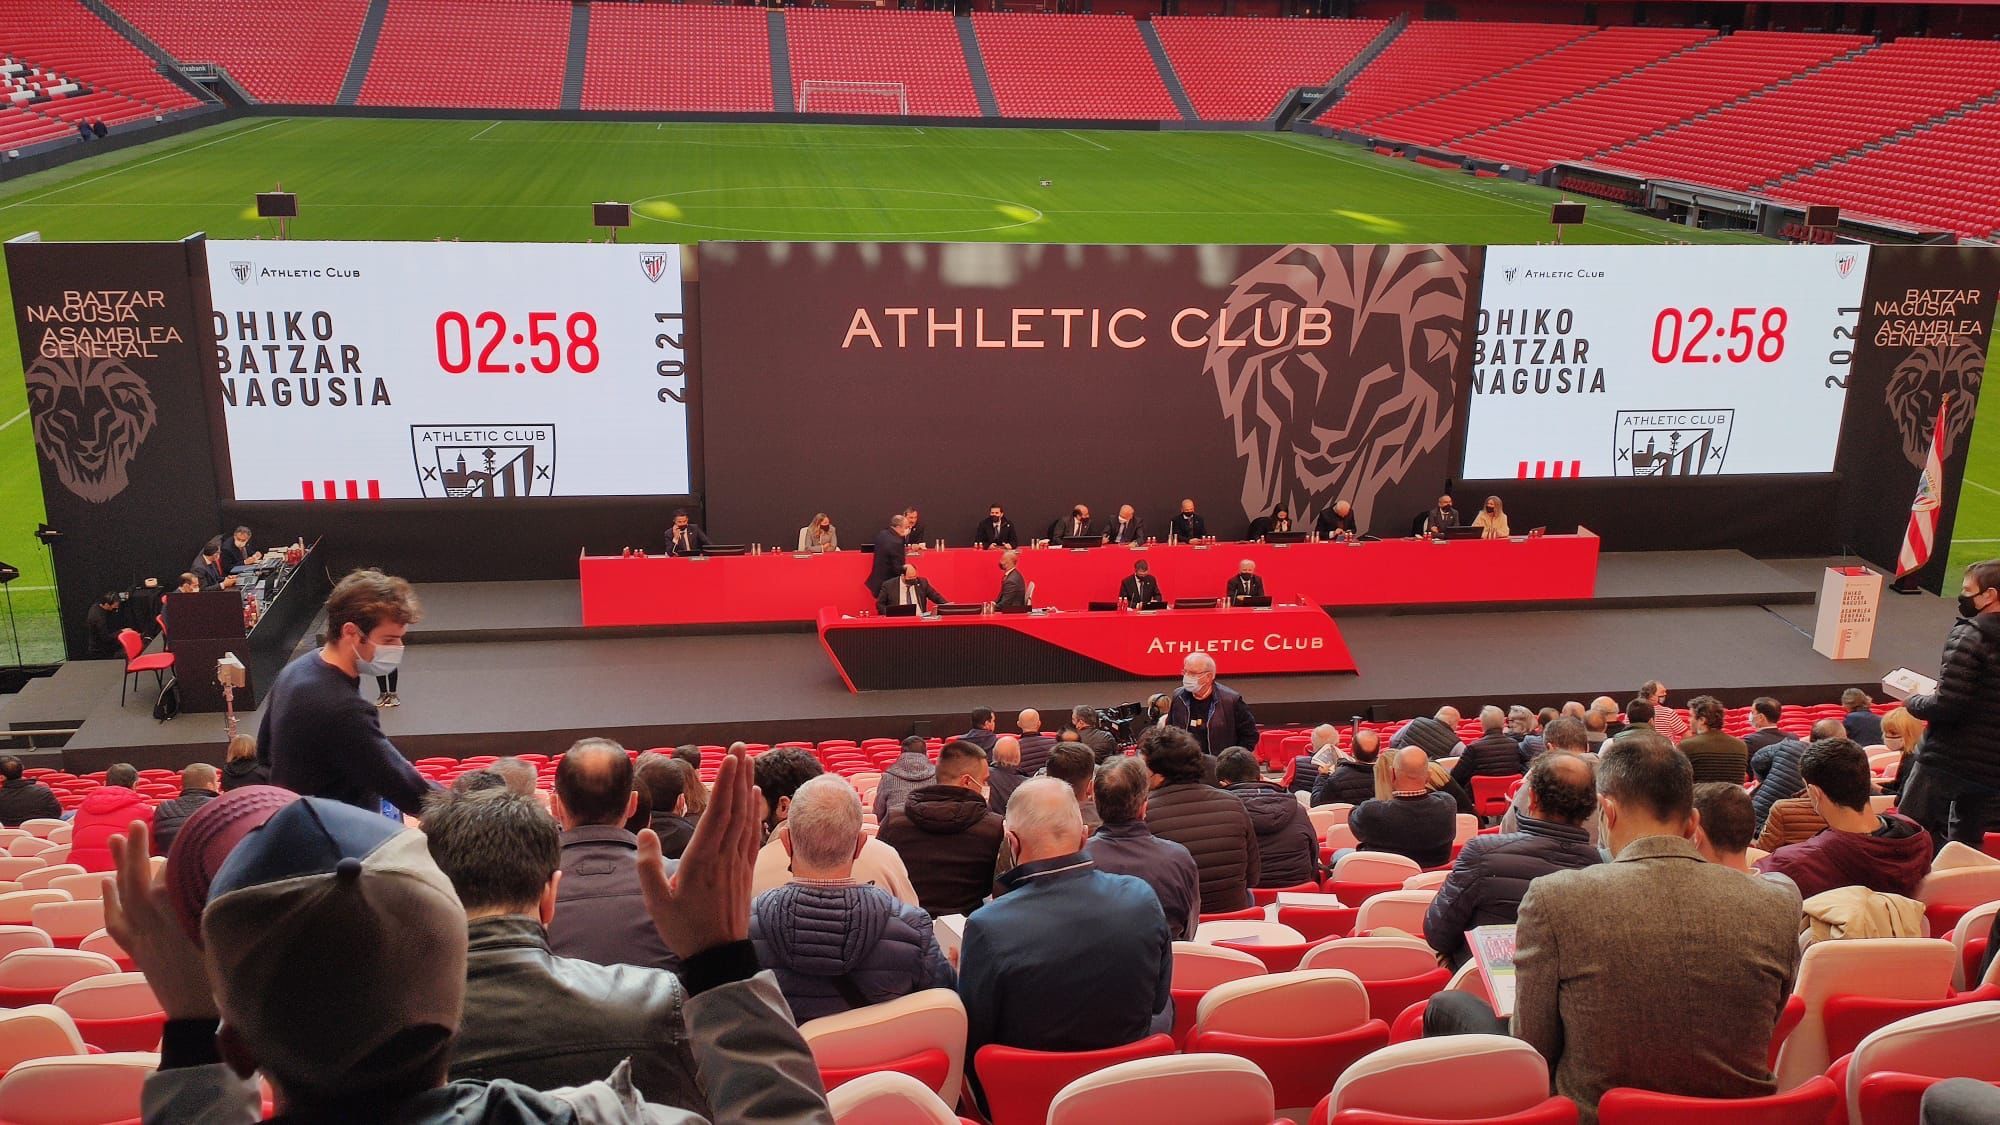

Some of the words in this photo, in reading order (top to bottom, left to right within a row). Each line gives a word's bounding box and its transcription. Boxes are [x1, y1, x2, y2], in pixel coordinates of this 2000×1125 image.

[63, 290, 165, 308] BATZAR
[1874, 301, 1956, 317] NAGUSIA
[1905, 289, 1980, 304] BATZAR
[27, 305, 139, 323] NAGUSIA
[212, 311, 333, 341] OHIKO
[841, 307, 1146, 348] ATHLETIC
[1170, 307, 1333, 348] CLUB
[1477, 308, 1573, 335] OHIKO
[1879, 320, 1982, 335] ASAMBLEA
[42, 326, 183, 343] ASAMBLEA
[435, 311, 600, 374] 02:58
[1651, 307, 1788, 364] 02:58
[1825, 307, 1862, 389] 2021
[1874, 333, 1961, 347] GENERAL
[40, 342, 159, 358] GENERAL
[217, 345, 362, 374] BATZAR
[654, 312, 686, 403] 2021
[1474, 338, 1590, 365] BATZAR
[220, 377, 392, 407] NAGUSIA
[1471, 367, 1606, 395] NAGUSIA
[1624, 416, 1688, 426] ATHLETIC
[1690, 415, 1726, 425] CLUB
[422, 431, 498, 442] ATHLETIC
[503, 430, 546, 442] CLUB
